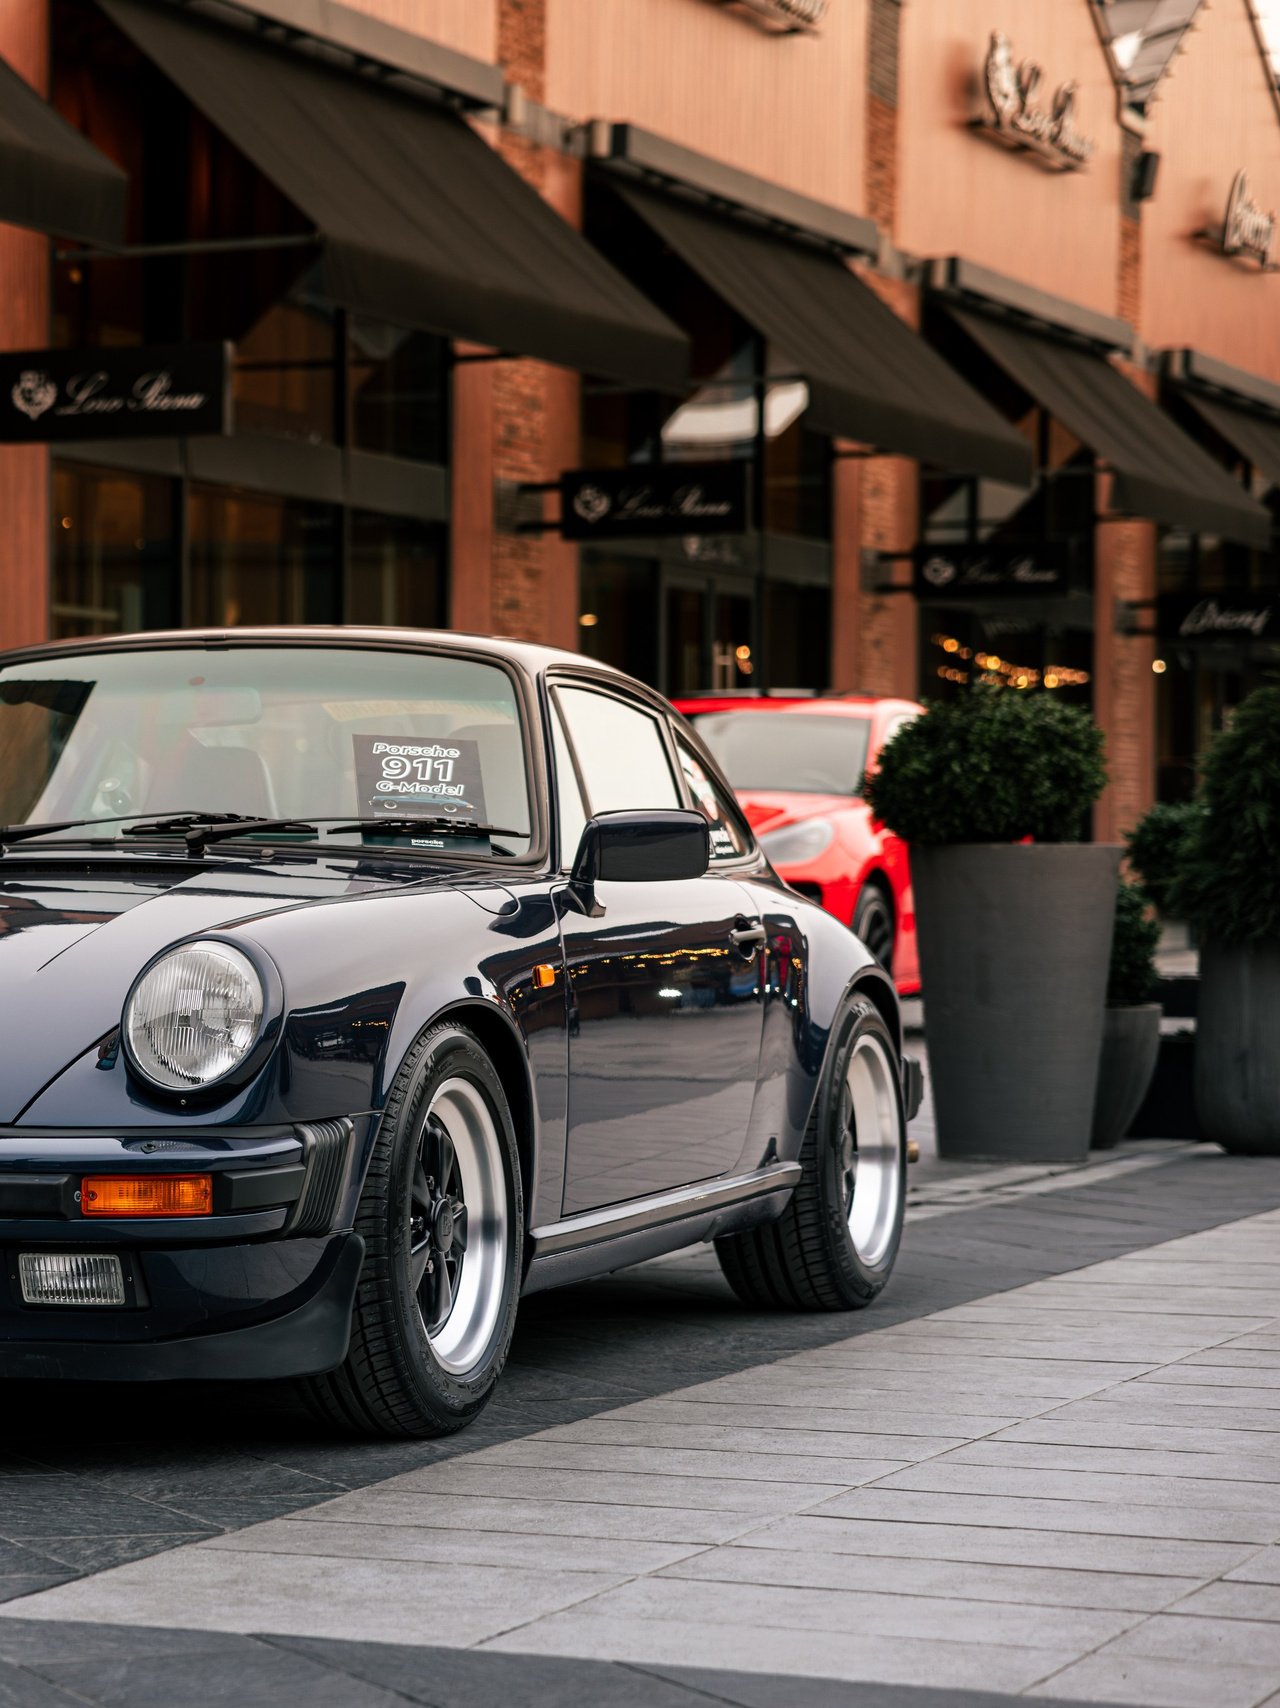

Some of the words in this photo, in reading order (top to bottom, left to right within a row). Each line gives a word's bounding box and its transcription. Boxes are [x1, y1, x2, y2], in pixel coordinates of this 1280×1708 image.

[372, 742, 460, 758] Porsche
[381, 756, 455, 782] 911
[376, 780, 464, 796] G-Model
